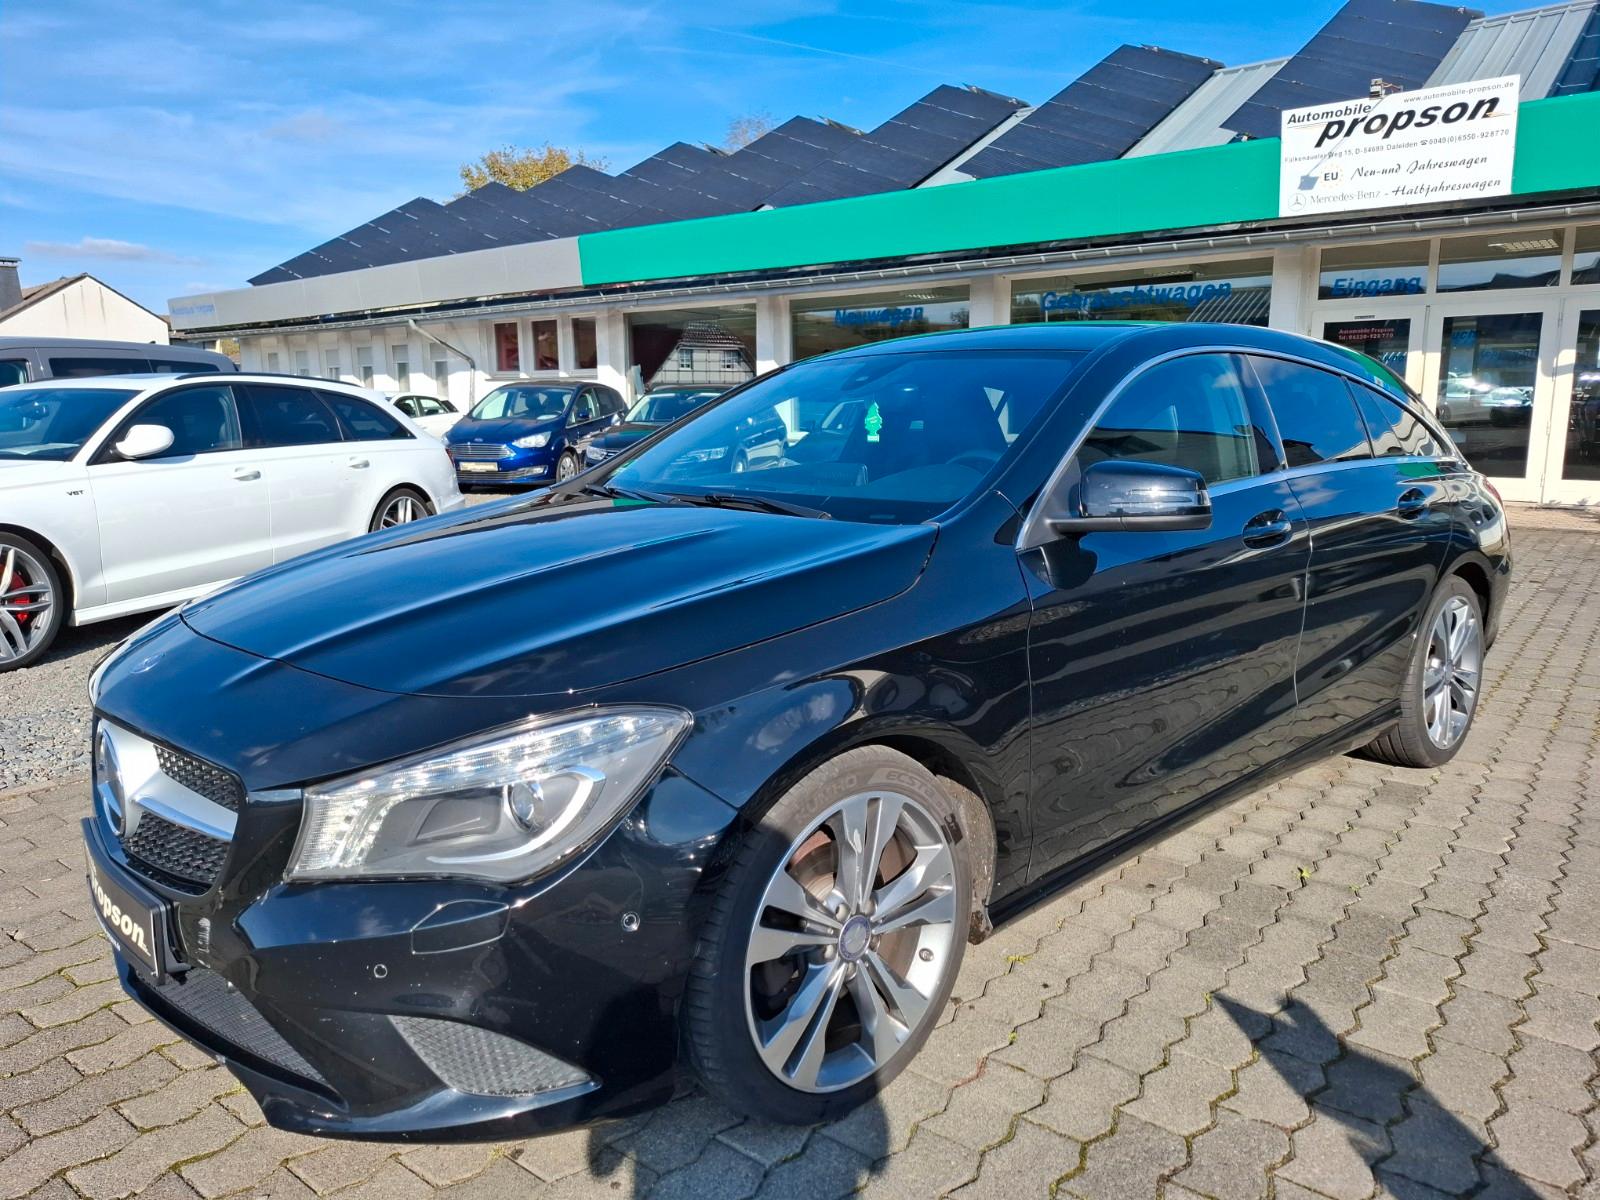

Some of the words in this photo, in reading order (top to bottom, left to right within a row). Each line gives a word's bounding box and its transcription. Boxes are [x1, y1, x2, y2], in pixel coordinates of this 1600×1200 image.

[1287, 103, 1371, 125] Automobile
[1314, 96, 1500, 148] propson
[1386, 141, 1418, 151] Daleiden
[1406, 157, 1488, 174] Jahreswagen
[1323, 171, 1339, 181] EU
[1391, 179, 1501, 197] Halbjahreswagen
[1041, 282, 1232, 311] Gebrauchtwagen
[1331, 277, 1422, 297] Eingang
[834, 306, 924, 328] Neuwagen
